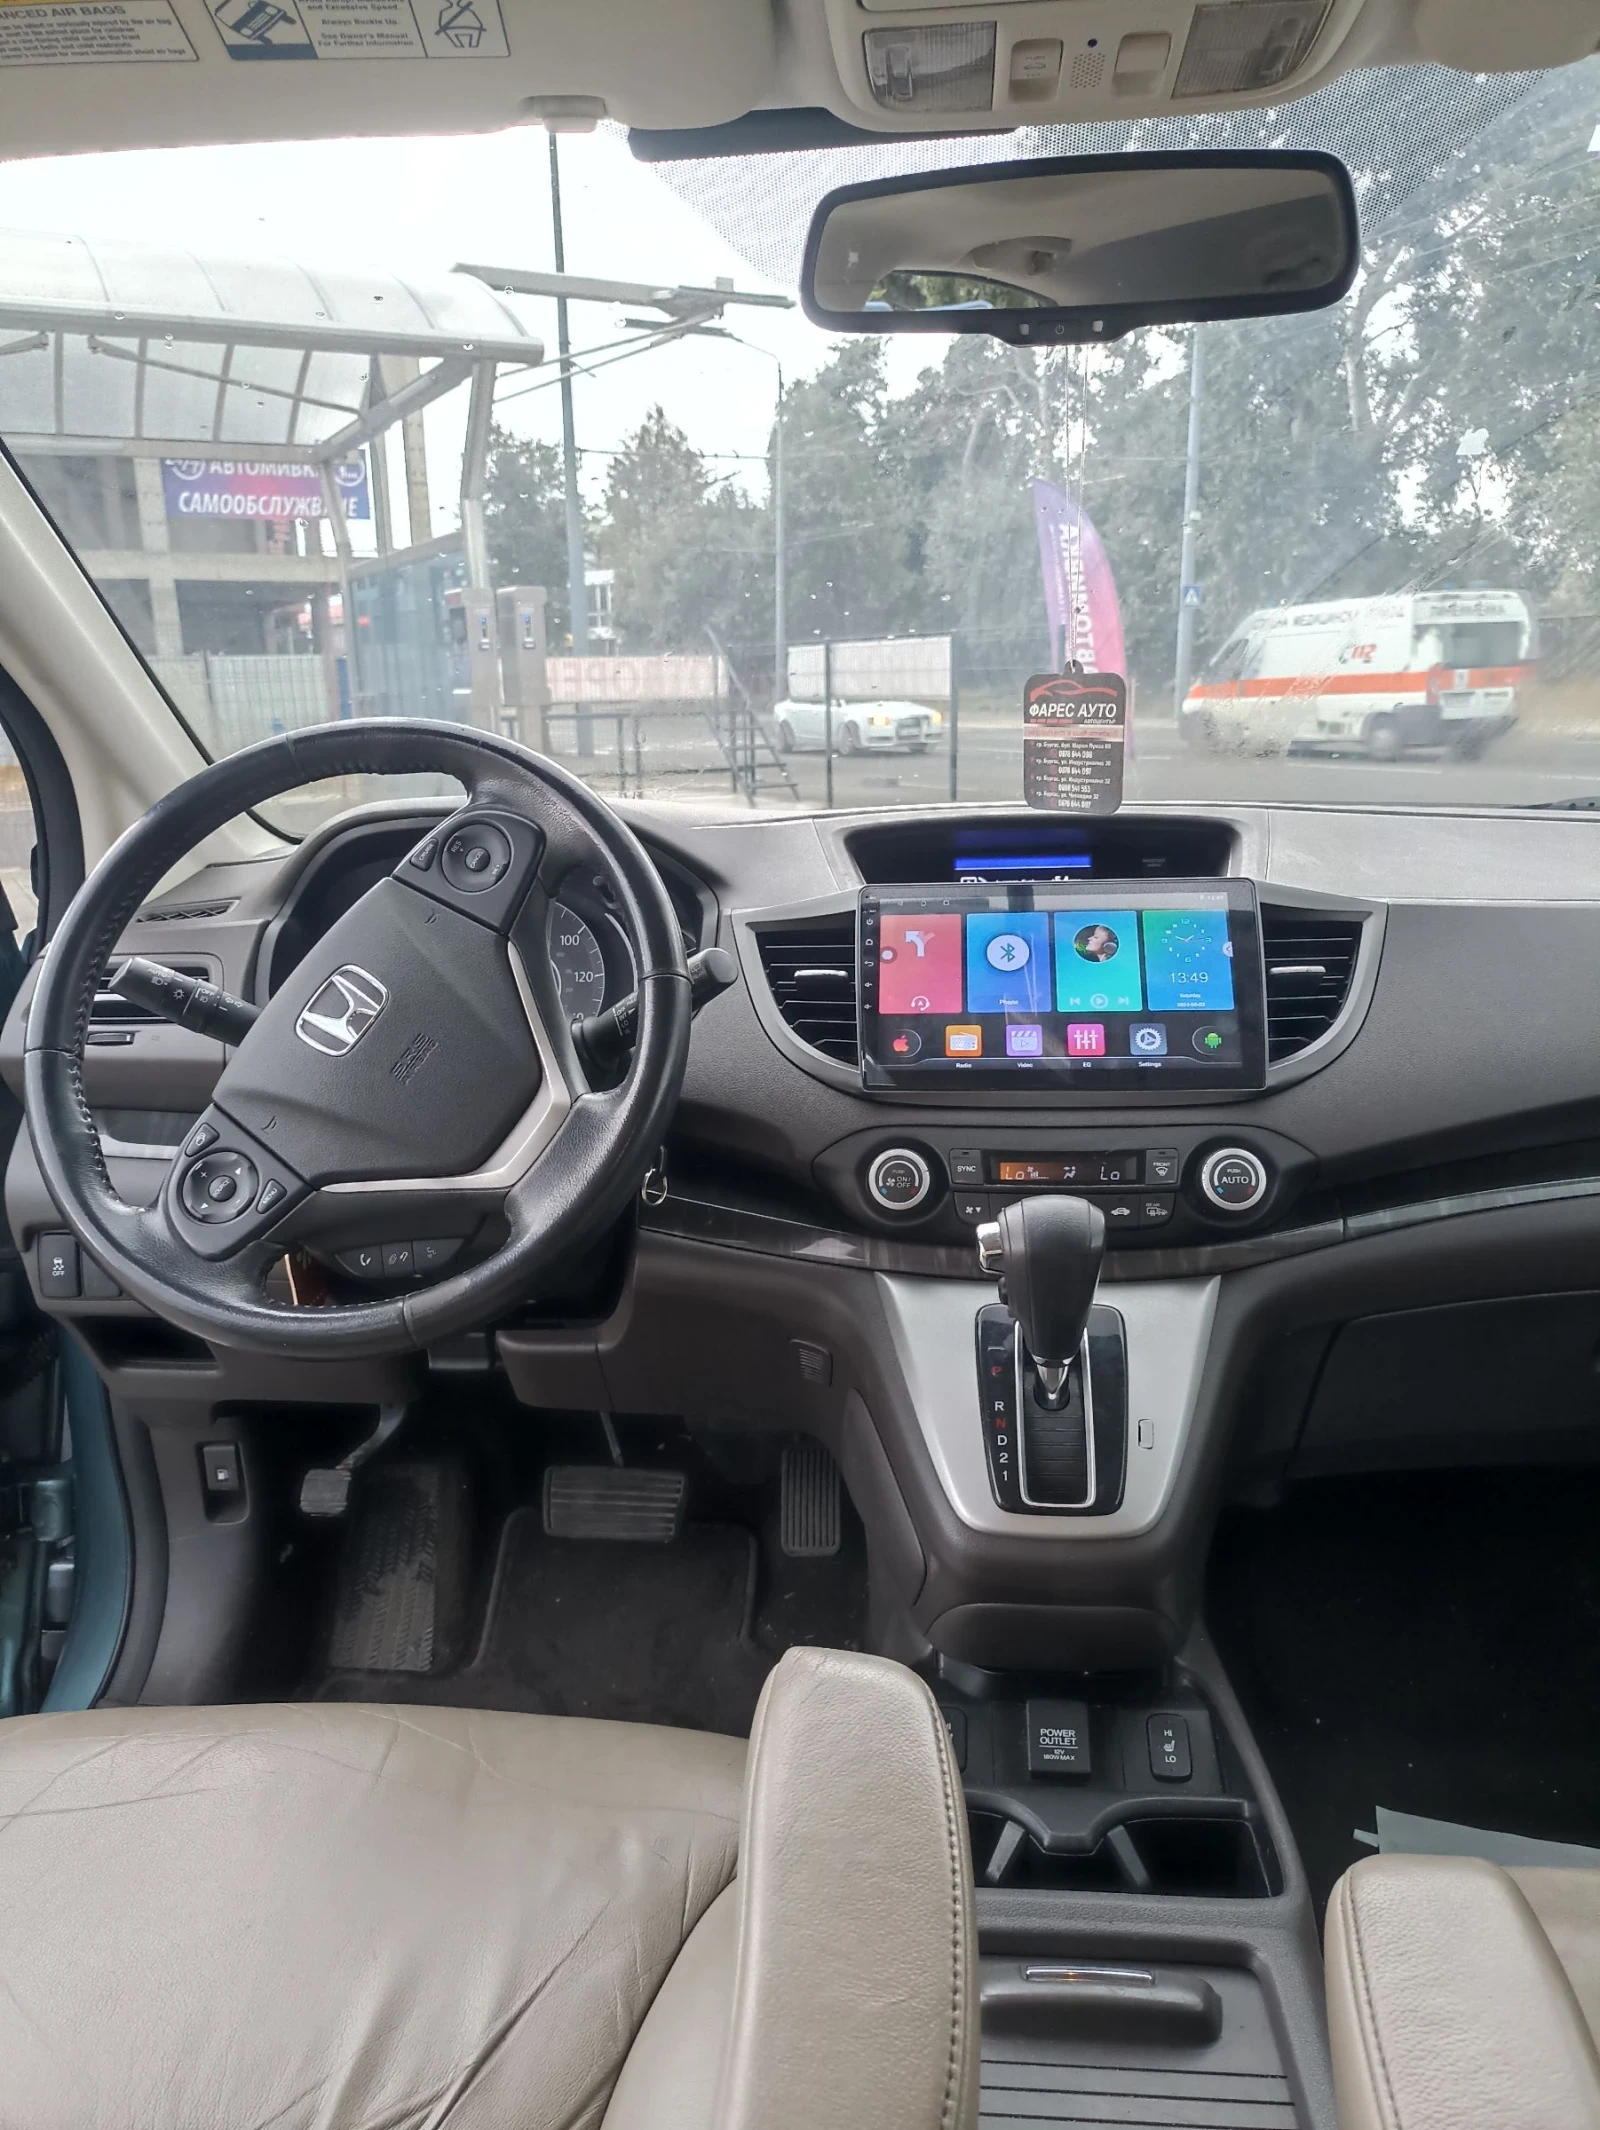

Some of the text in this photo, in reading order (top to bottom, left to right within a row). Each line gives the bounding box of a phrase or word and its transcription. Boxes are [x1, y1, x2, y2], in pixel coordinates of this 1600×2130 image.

[52, 8, 77, 17] AIR
[80, 6, 126, 15] BAGS
[209, 459, 319, 478] АВТОМИВК
[1029, 703, 1117, 718] ФАРЕС АУТО
[451, 840, 462, 852] RES
[560, 935, 580, 946] 100
[574, 971, 594, 983] 120
[1170, 972, 1209, 984] 13:49
[1138, 1061, 1162, 1069] Settings
[957, 1165, 976, 1173] SYNC
[1221, 1176, 1249, 1184] AUTO
[991, 1366, 1002, 1377] P
[994, 1401, 1004, 1411] R
[996, 1418, 1006, 1428] N
[997, 1435, 1008, 1446] D
[1000, 1452, 1008, 1463] 2
[1003, 1470, 1008, 1481] 1
[1040, 1728, 1075, 1737] POWER
[1039, 1737, 1077, 1746] OUTLET
[1165, 1755, 1176, 1763] LO
